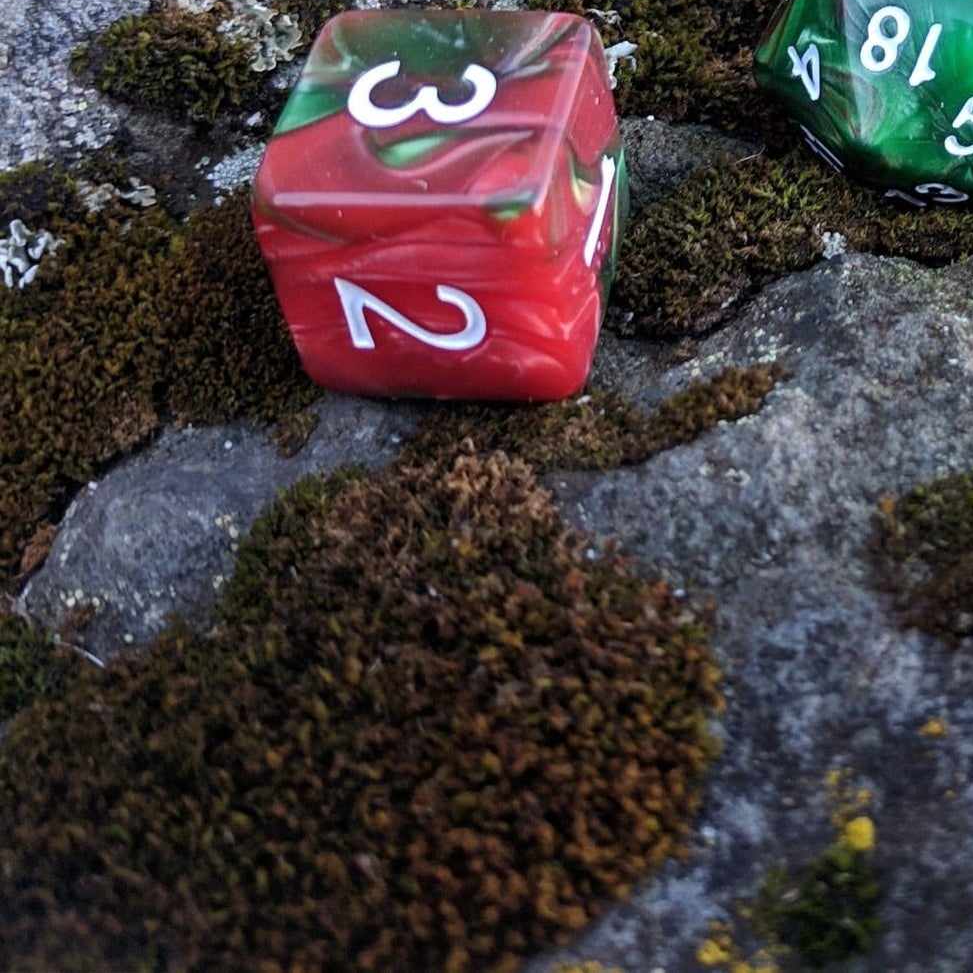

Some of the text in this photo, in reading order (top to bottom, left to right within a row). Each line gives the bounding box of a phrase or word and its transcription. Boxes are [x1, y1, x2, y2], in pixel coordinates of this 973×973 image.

[787, 44, 820, 101] 4
[860, 6, 943, 86] 18
[347, 59, 498, 127] 3
[583, 154, 615, 268] 1
[334, 277, 488, 351] 2
